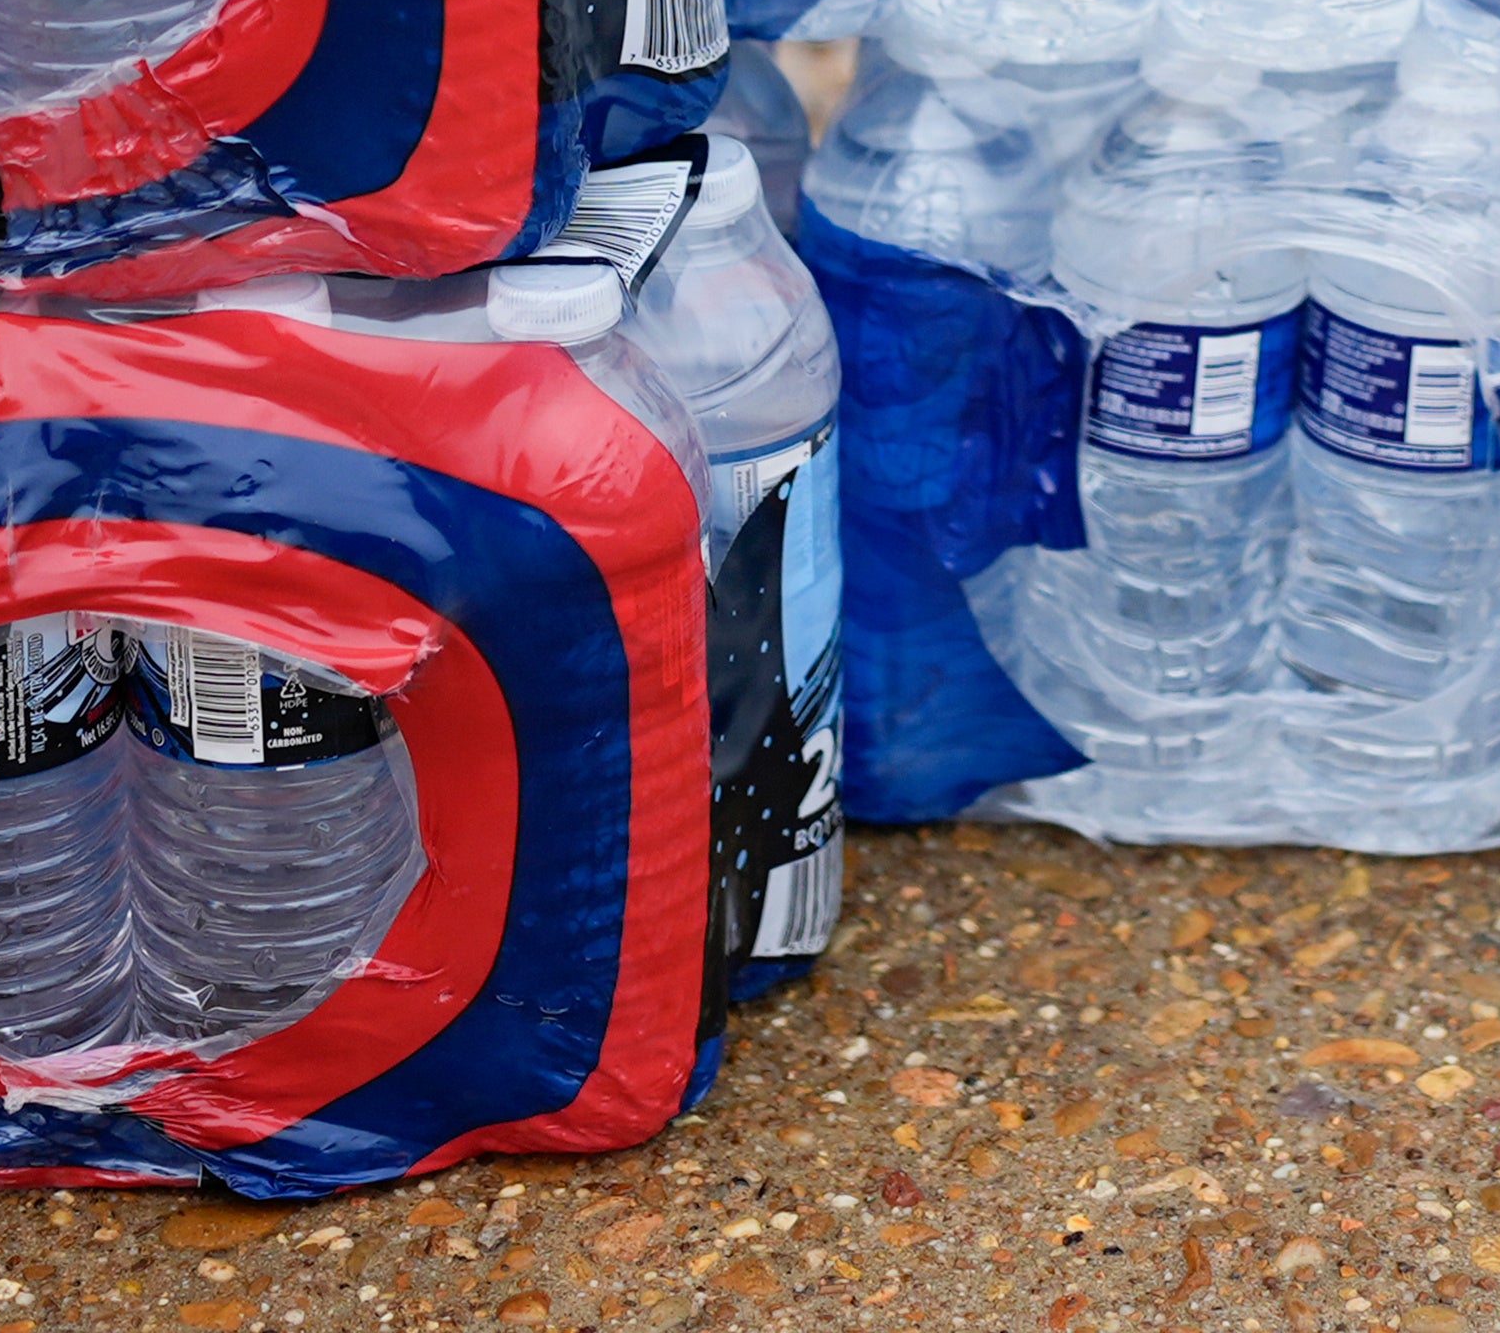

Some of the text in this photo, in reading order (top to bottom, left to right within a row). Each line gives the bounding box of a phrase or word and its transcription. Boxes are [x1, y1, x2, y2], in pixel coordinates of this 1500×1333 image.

[643, 190, 681, 247] 00207
[279, 698, 308, 708] HDPE
[247, 693, 260, 731] 65317
[81, 728, 97, 748] Net
[283, 726, 306, 737] NON-
[267, 733, 323, 748] CARBONATED
